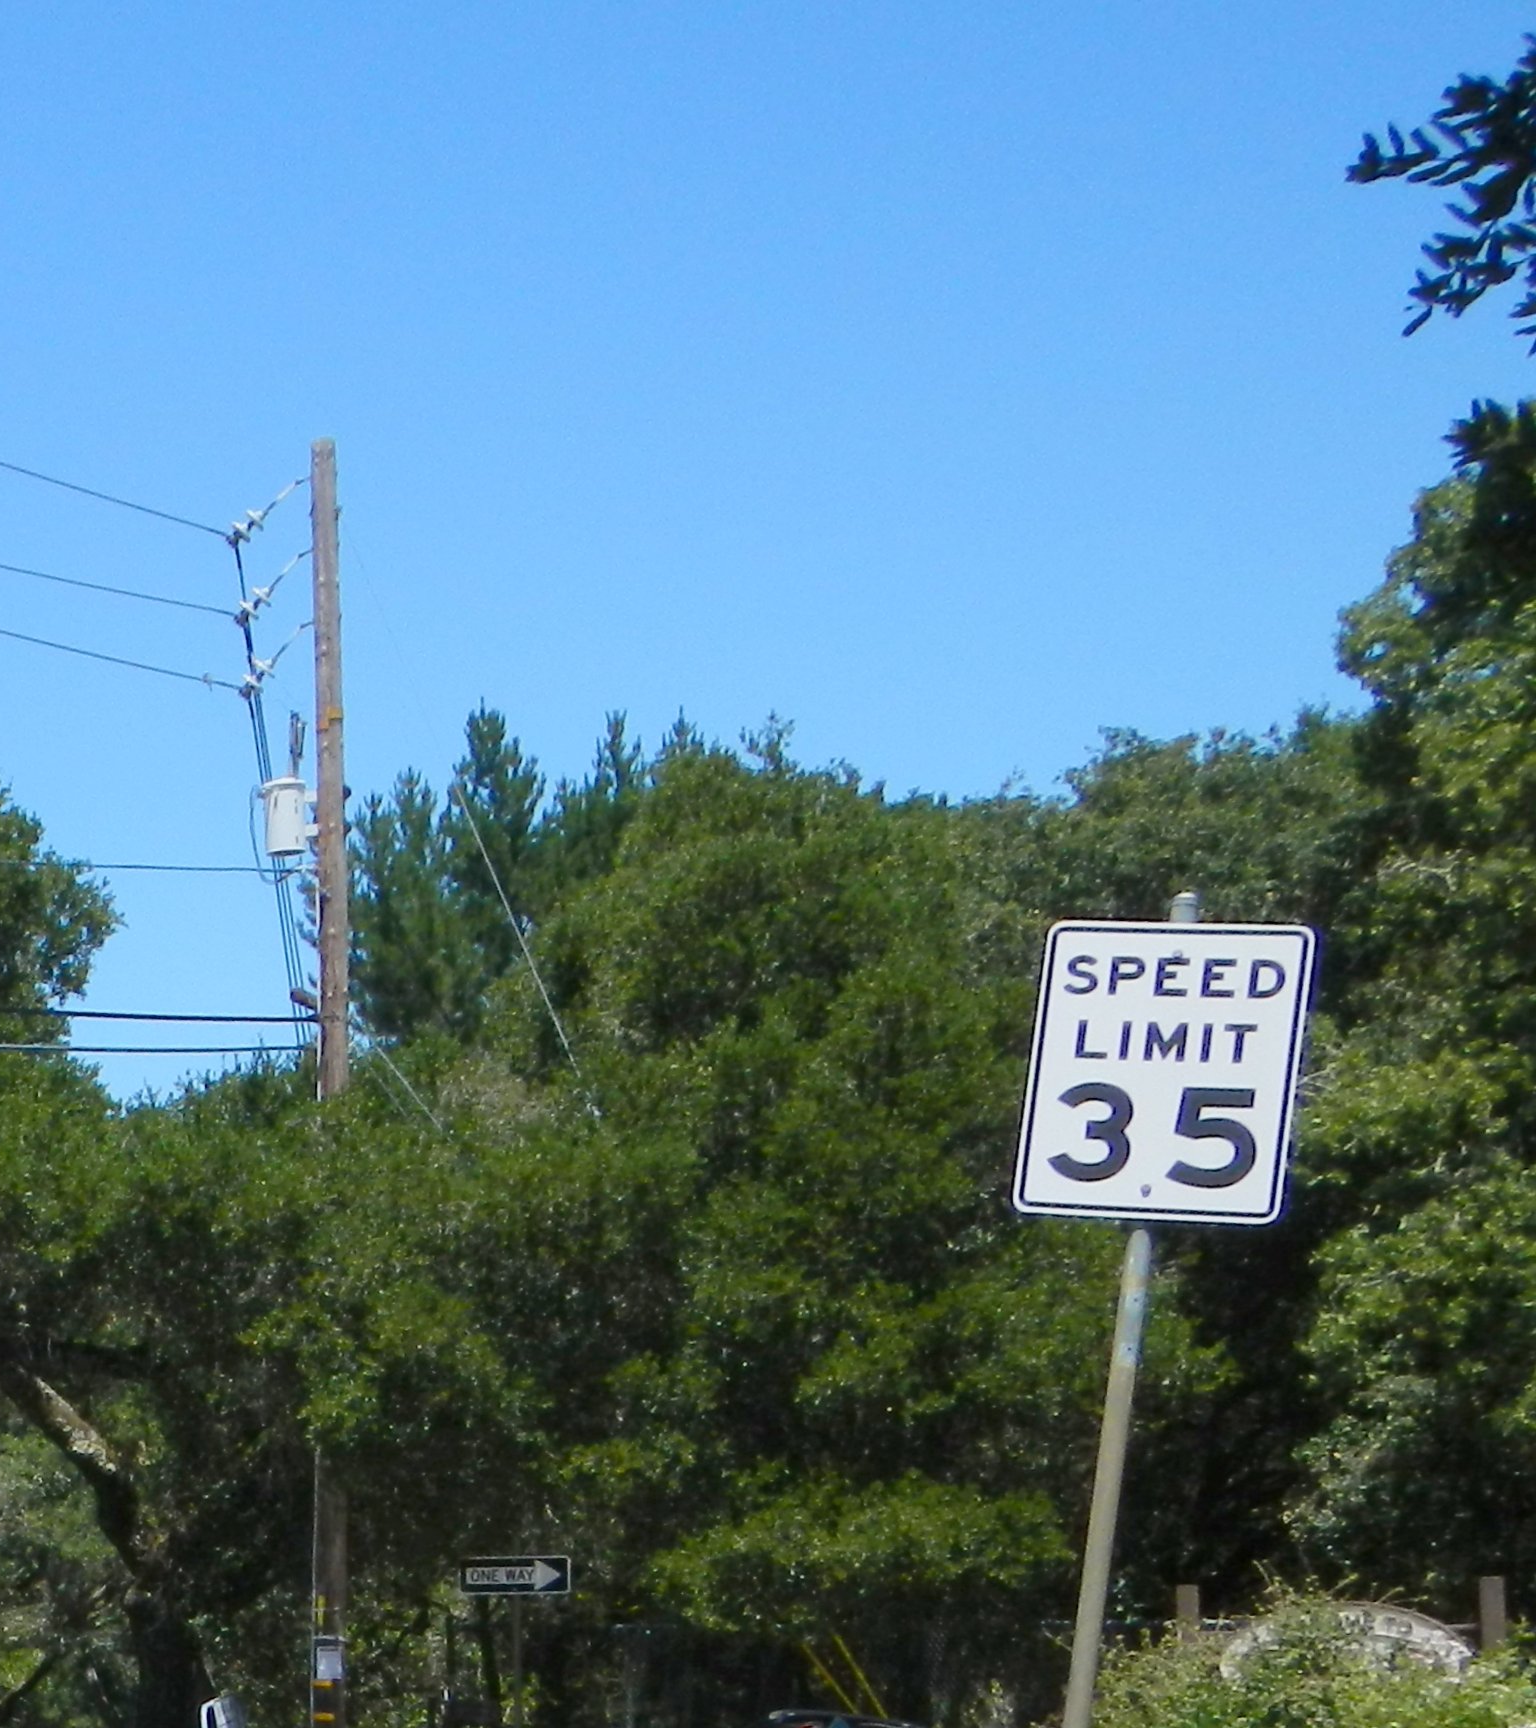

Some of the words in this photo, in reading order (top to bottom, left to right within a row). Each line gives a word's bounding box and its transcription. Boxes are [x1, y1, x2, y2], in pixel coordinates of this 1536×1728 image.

[1063, 954, 1286, 999] SPEED
[1074, 1019, 1258, 1063] LIMIT
[1047, 1082, 1257, 1189] 35
[471, 1568, 500, 1582] ONE
[504, 1568, 535, 1582] WAY
